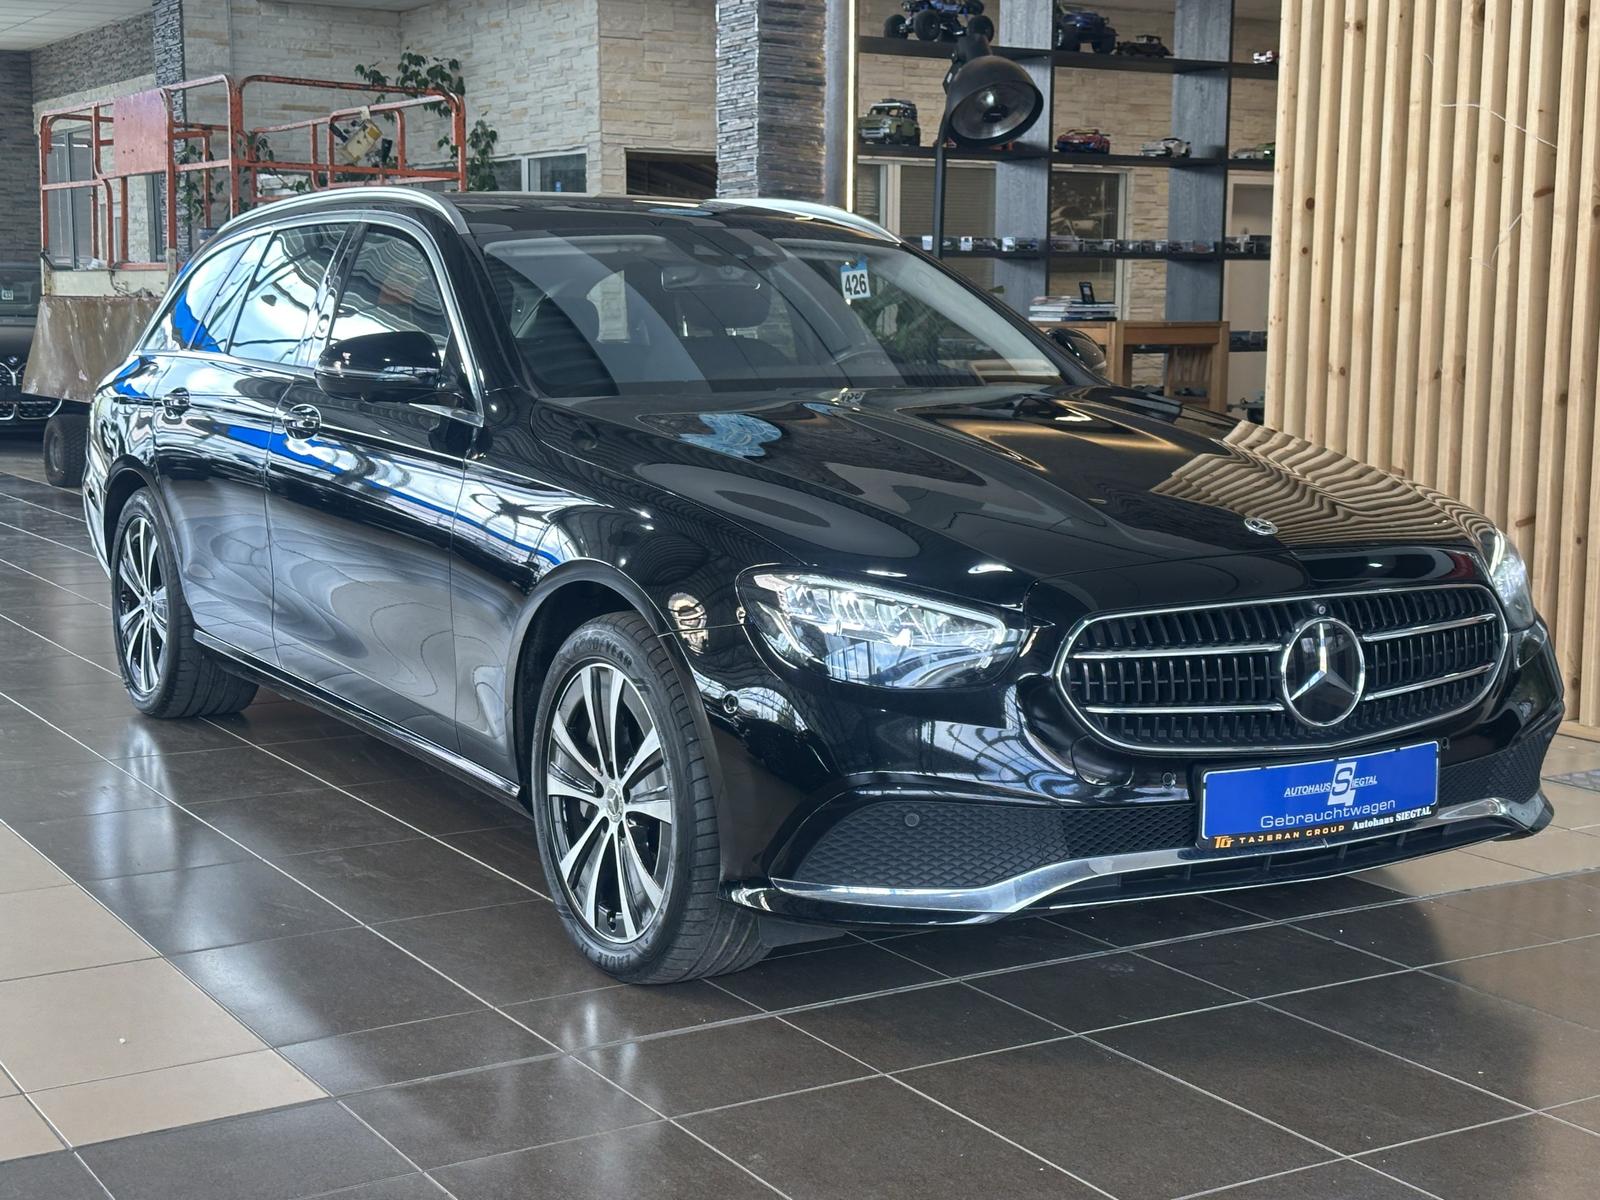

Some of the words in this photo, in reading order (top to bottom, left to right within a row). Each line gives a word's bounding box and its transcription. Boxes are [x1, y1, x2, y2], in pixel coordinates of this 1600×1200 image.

[845, 273, 867, 296] 426
[1283, 782, 1332, 798] AUTOHAUS
[1260, 799, 1396, 828] Gebrauchtwagen
[1351, 816, 1394, 831] Autohaus
[1395, 806, 1432, 822] SIEGTAL
[1239, 831, 1300, 844] TAJERAN
[1306, 825, 1345, 837] GROUP
